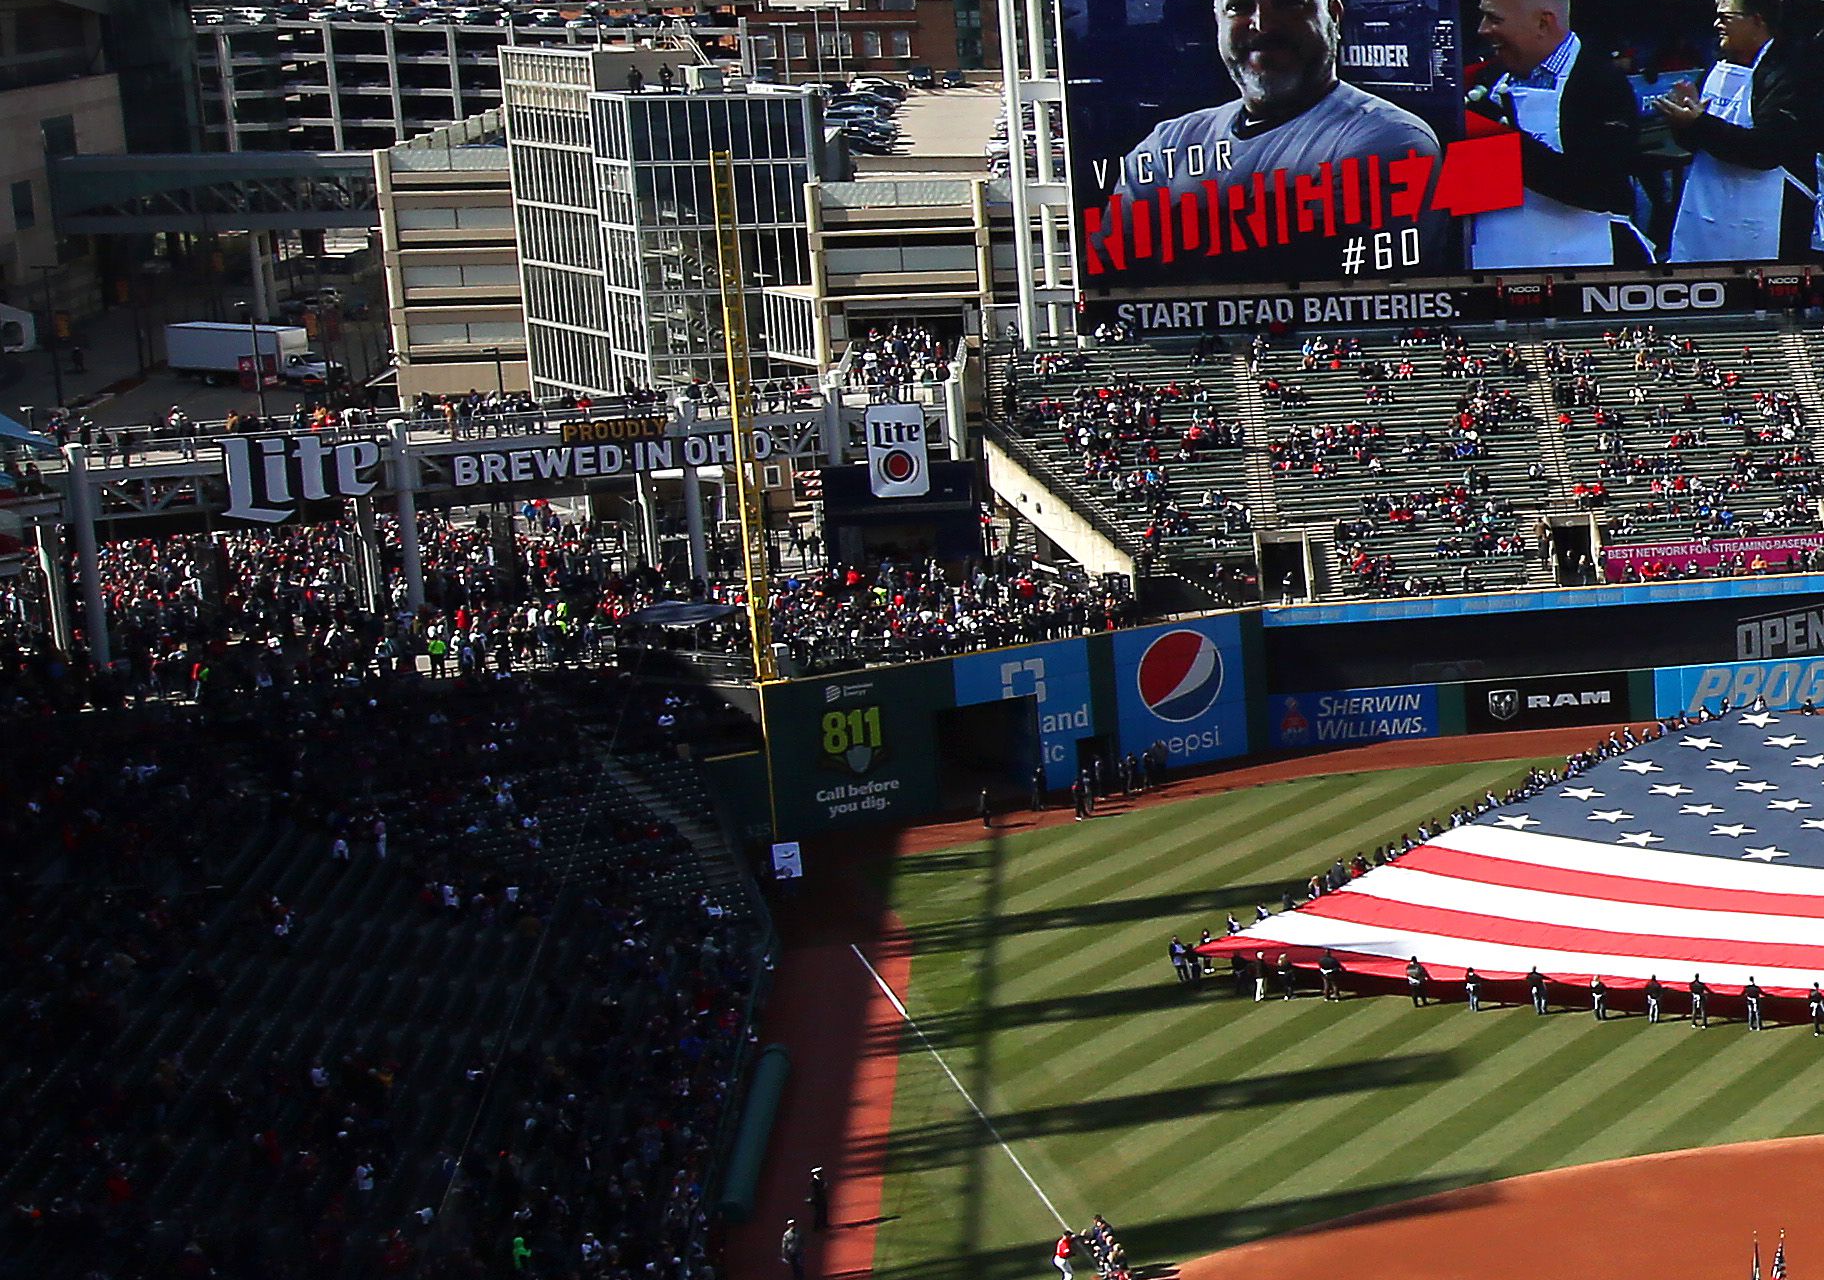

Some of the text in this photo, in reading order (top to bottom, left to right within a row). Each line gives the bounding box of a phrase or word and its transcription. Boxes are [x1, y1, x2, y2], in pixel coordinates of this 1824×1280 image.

[1340, 45, 1409, 67] LOUDER
[1092, 139, 1233, 190] VICTOR
[1341, 228, 1421, 276] #60
[1508, 285, 1541, 294] NOCO
[1768, 276, 1799, 285] NOCO
[1117, 299, 1210, 331] START
[1300, 291, 1461, 323] BATTERIES.
[1582, 282, 1726, 313] NOCO
[561, 418, 667, 443] PROUDLY
[869, 420, 922, 449] Lite
[454, 430, 772, 487] BREWED IN OHO
[219, 433, 381, 523] Lite
[1608, 547, 1633, 560] BEST
[1636, 544, 1689, 559] NETWORK
[1691, 543, 1711, 556] FOR
[1712, 540, 1772, 555] STREAMING
[1317, 693, 1421, 718] SHERWIN
[1527, 689, 1611, 709] RAM
[822, 706, 882, 754] 811
[1151, 725, 1223, 763] pepsi
[816, 779, 900, 802] Call before
[829, 796, 891, 818] you dig.
